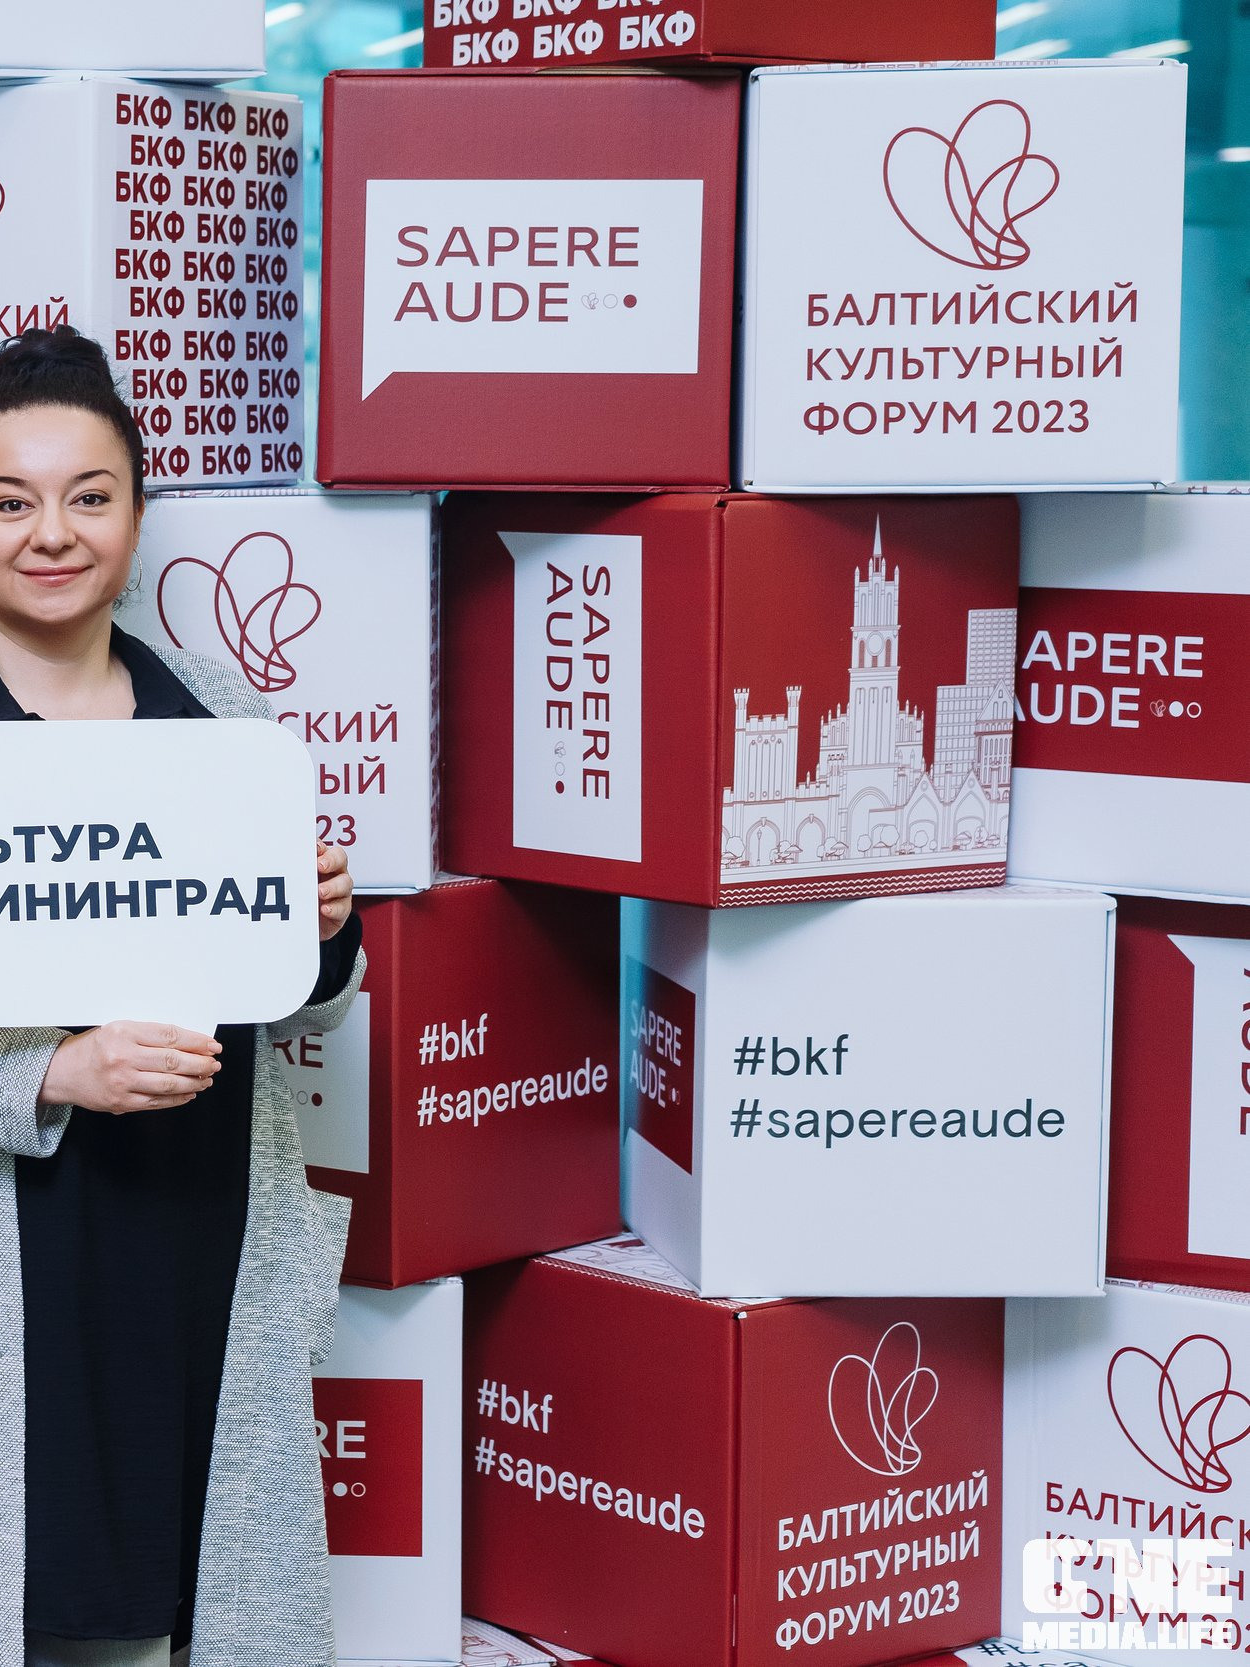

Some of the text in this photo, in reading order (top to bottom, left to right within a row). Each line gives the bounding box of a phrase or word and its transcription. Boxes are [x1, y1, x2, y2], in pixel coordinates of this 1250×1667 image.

[434, 0, 499, 27] БКФ
[453, 11, 695, 66] БКФ БКФ БКФ
[114, 94, 288, 140] БКФ БКФ БКФ
[131, 135, 298, 179] БКФ БКФ БКФ
[114, 171, 287, 213] БКФ БКФ БКФ
[114, 249, 287, 286] БКФ БКФ БКФ
[397, 226, 639, 267] SAPERE
[131, 287, 298, 321] БКФ БКФ БКФ
[394, 282, 569, 322] AUDE
[808, 282, 1137, 326] БАЛТИЙСКИЙ
[114, 329, 288, 362] БКФ БКФ БКФ
[807, 337, 1122, 380] КУЛЬТУРНЫЙ
[133, 368, 300, 400] БКФ БКФ БКФ
[804, 400, 1089, 435] ФОРУМ 2023
[546, 562, 573, 730] AUDE
[1022, 631, 1203, 677] APERE
[583, 565, 610, 799] SAPERE
[419, 1013, 487, 1065] #bkf
[630, 1000, 682, 1067] SAPERE
[734, 1034, 848, 1075] #bkf
[417, 1057, 608, 1127] #sapereaude
[629, 1050, 666, 1108] AUDE
[731, 1099, 1064, 1148] #sapereaude
[478, 1379, 552, 1433] #bkf
[476, 1437, 704, 1538] #sapereaude
[778, 1469, 988, 1551] БАЛТИЙСКИЙ
[777, 1520, 980, 1602] КУЛЬТУРНЫЙ
[775, 1580, 960, 1651] ФОРУМ 2023
